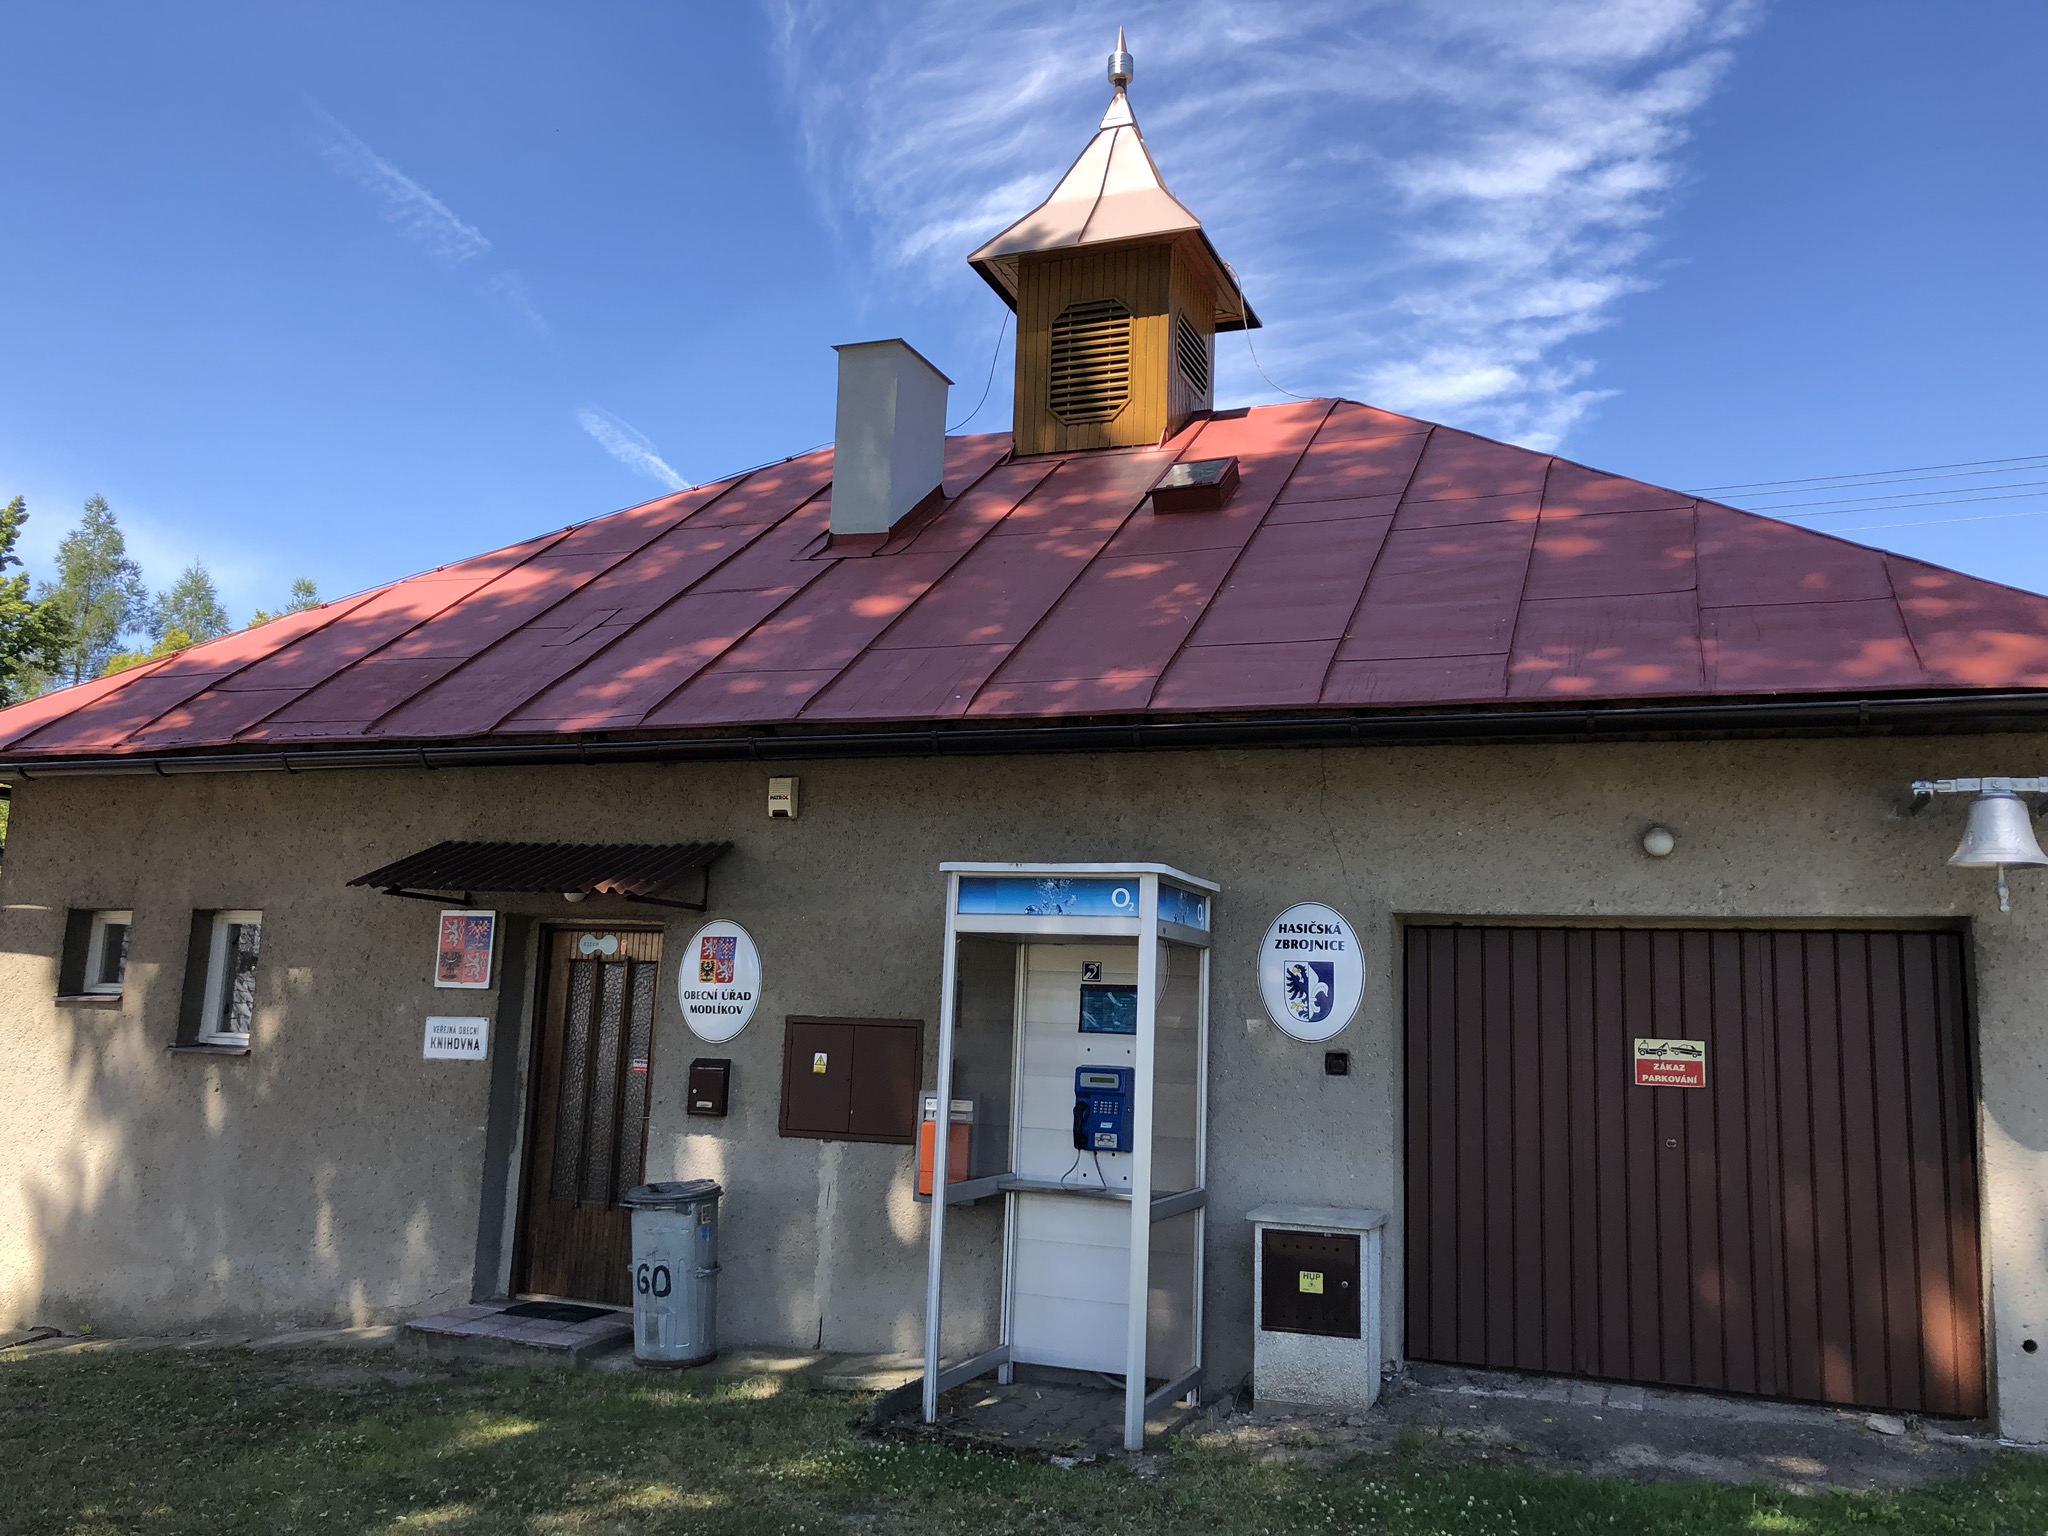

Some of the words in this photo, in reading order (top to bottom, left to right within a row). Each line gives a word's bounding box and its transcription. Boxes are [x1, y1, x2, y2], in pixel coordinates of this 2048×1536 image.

[1278, 921, 1341, 935] HASIČSKÁ
[1274, 939, 1345, 952] ZBROJNICE
[684, 989, 718, 1001] OBECNÍ
[721, 989, 752, 1001] ÚŘAD
[690, 1003, 744, 1015] MODLÍKOV
[433, 1024, 457, 1034] VEŘEJNÁ
[459, 1025, 480, 1035] OBECNÍ
[431, 1037, 480, 1051] KNIHOVNA
[1653, 1062, 1686, 1072] ZÁKAZ
[1642, 1074, 1698, 1084] PARKOVÁNÍ
[1303, 1272, 1321, 1281] HUP
